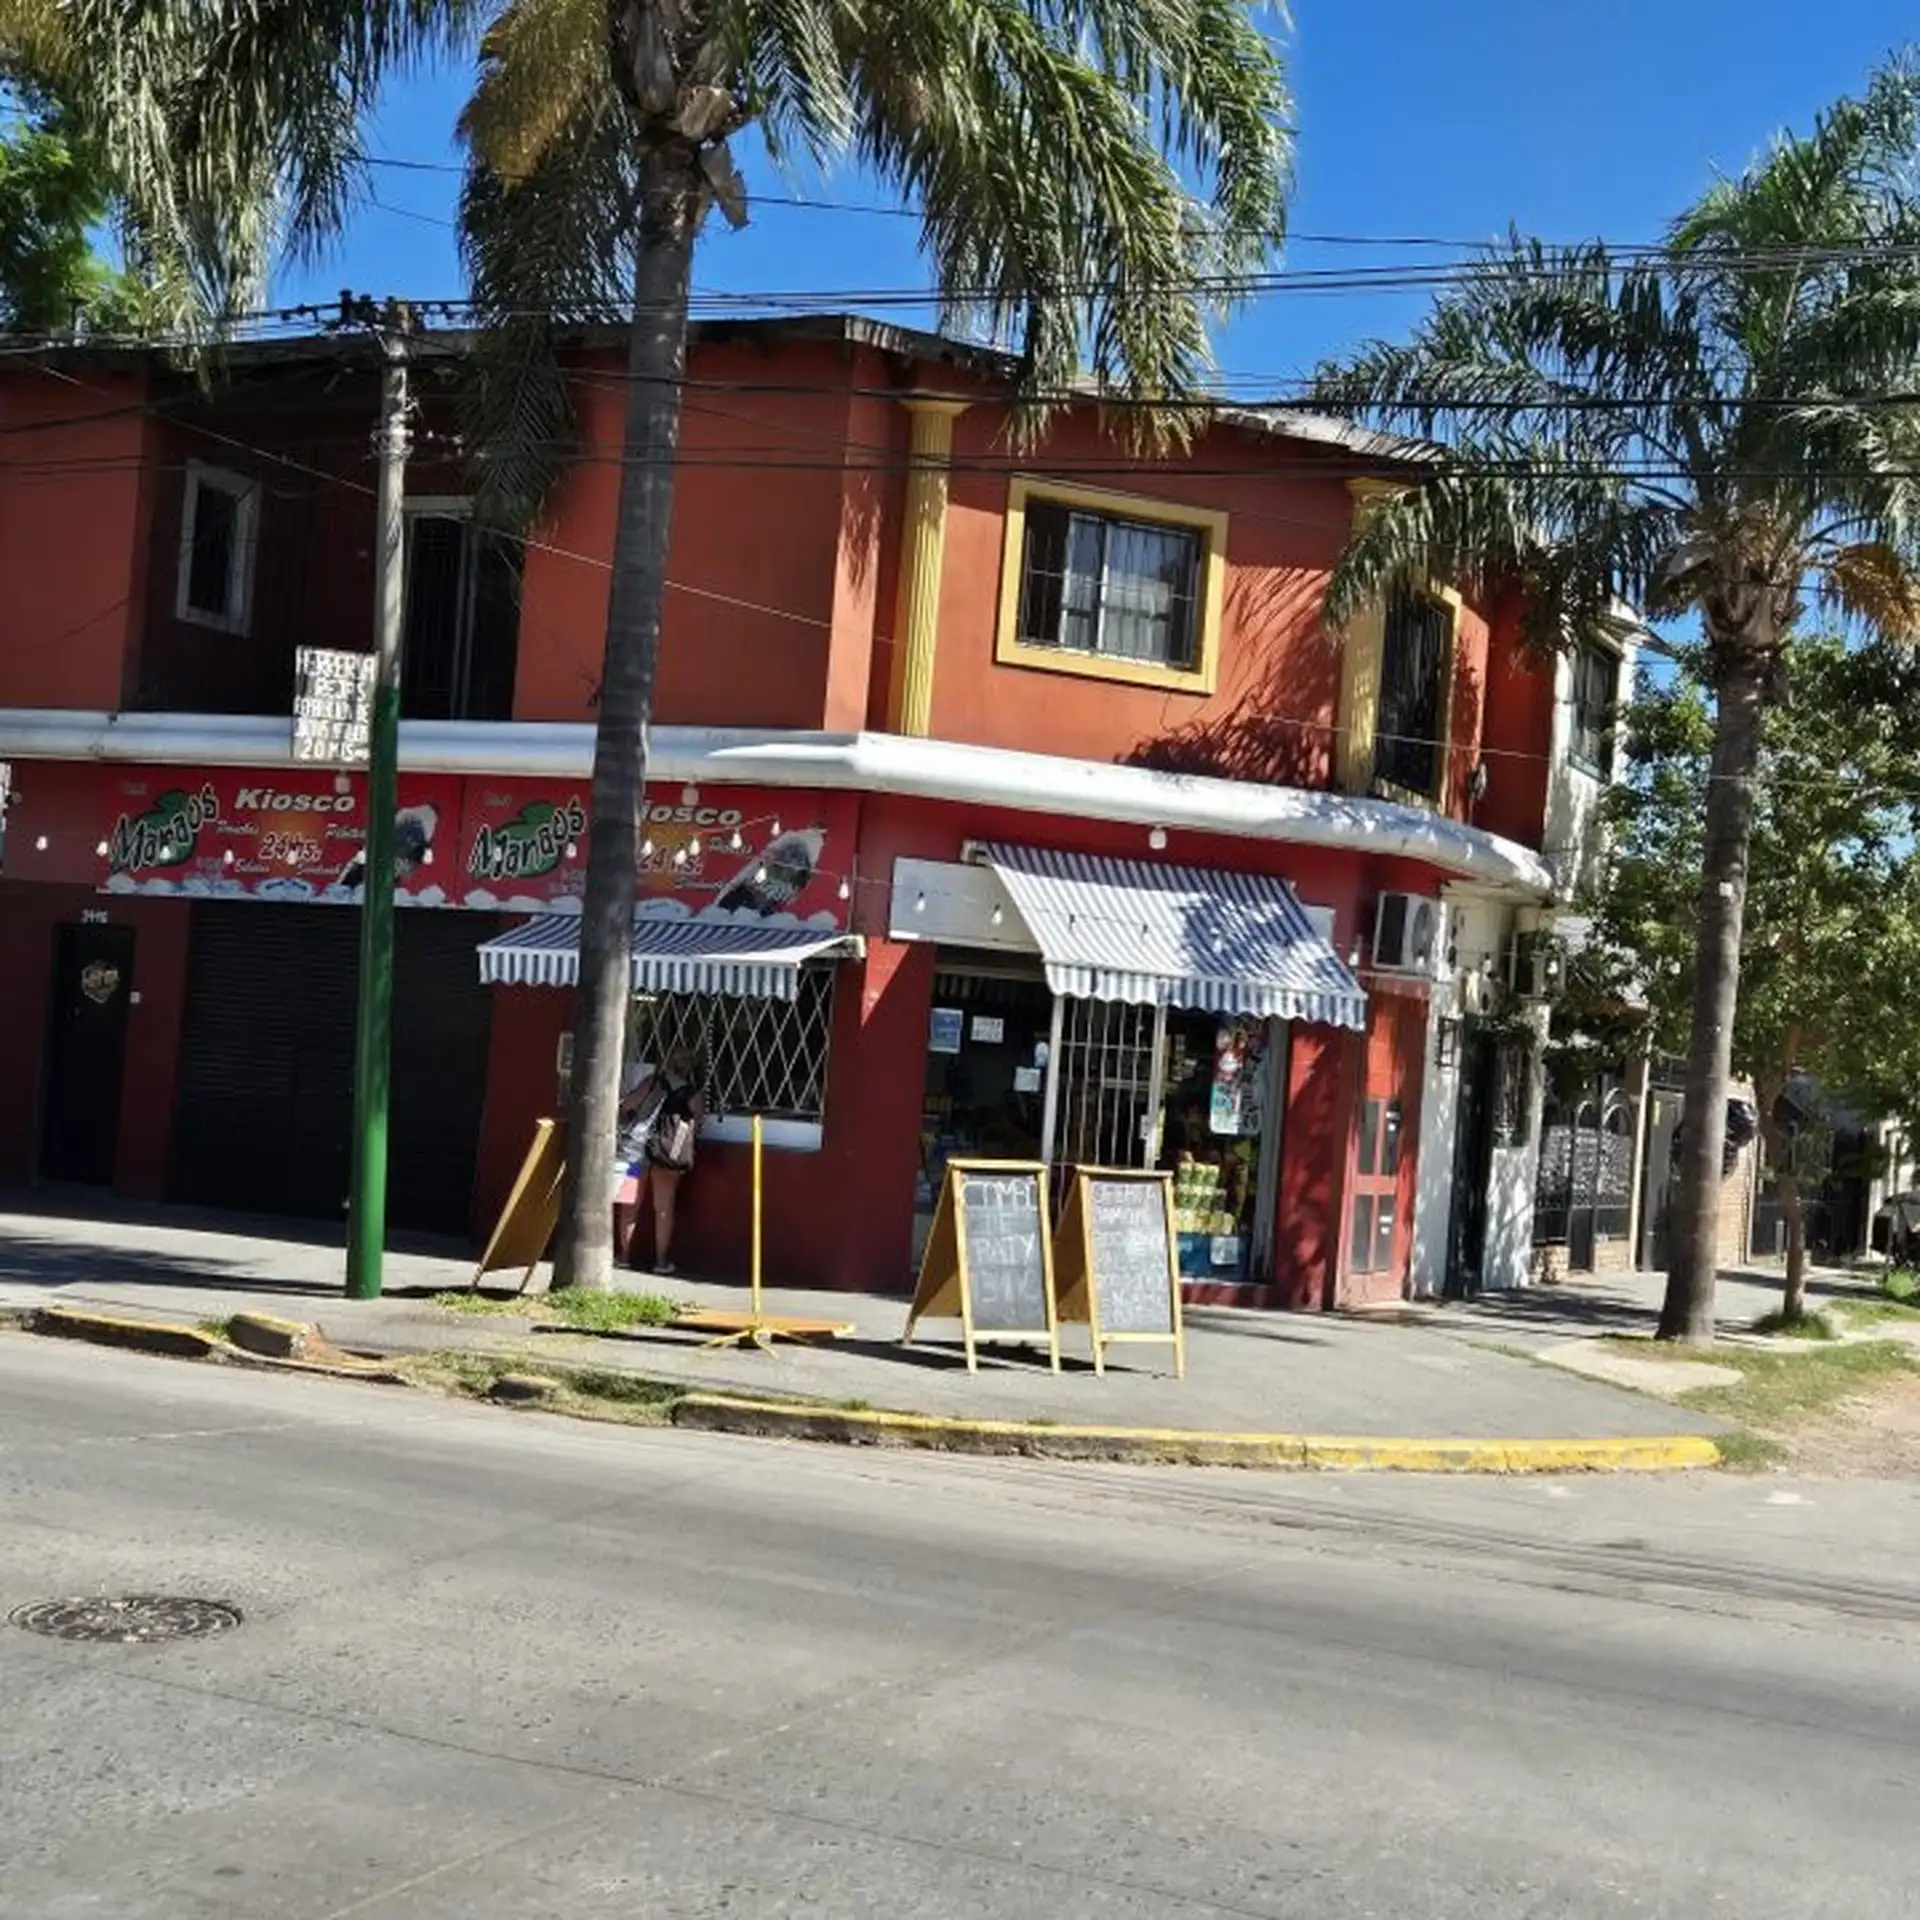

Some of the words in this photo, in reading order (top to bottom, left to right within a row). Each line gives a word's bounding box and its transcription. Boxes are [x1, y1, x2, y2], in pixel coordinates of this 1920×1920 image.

[234, 787, 355, 812] Kiosco
[638, 800, 742, 825] iosco
[975, 1233, 1036, 1265] PATY
